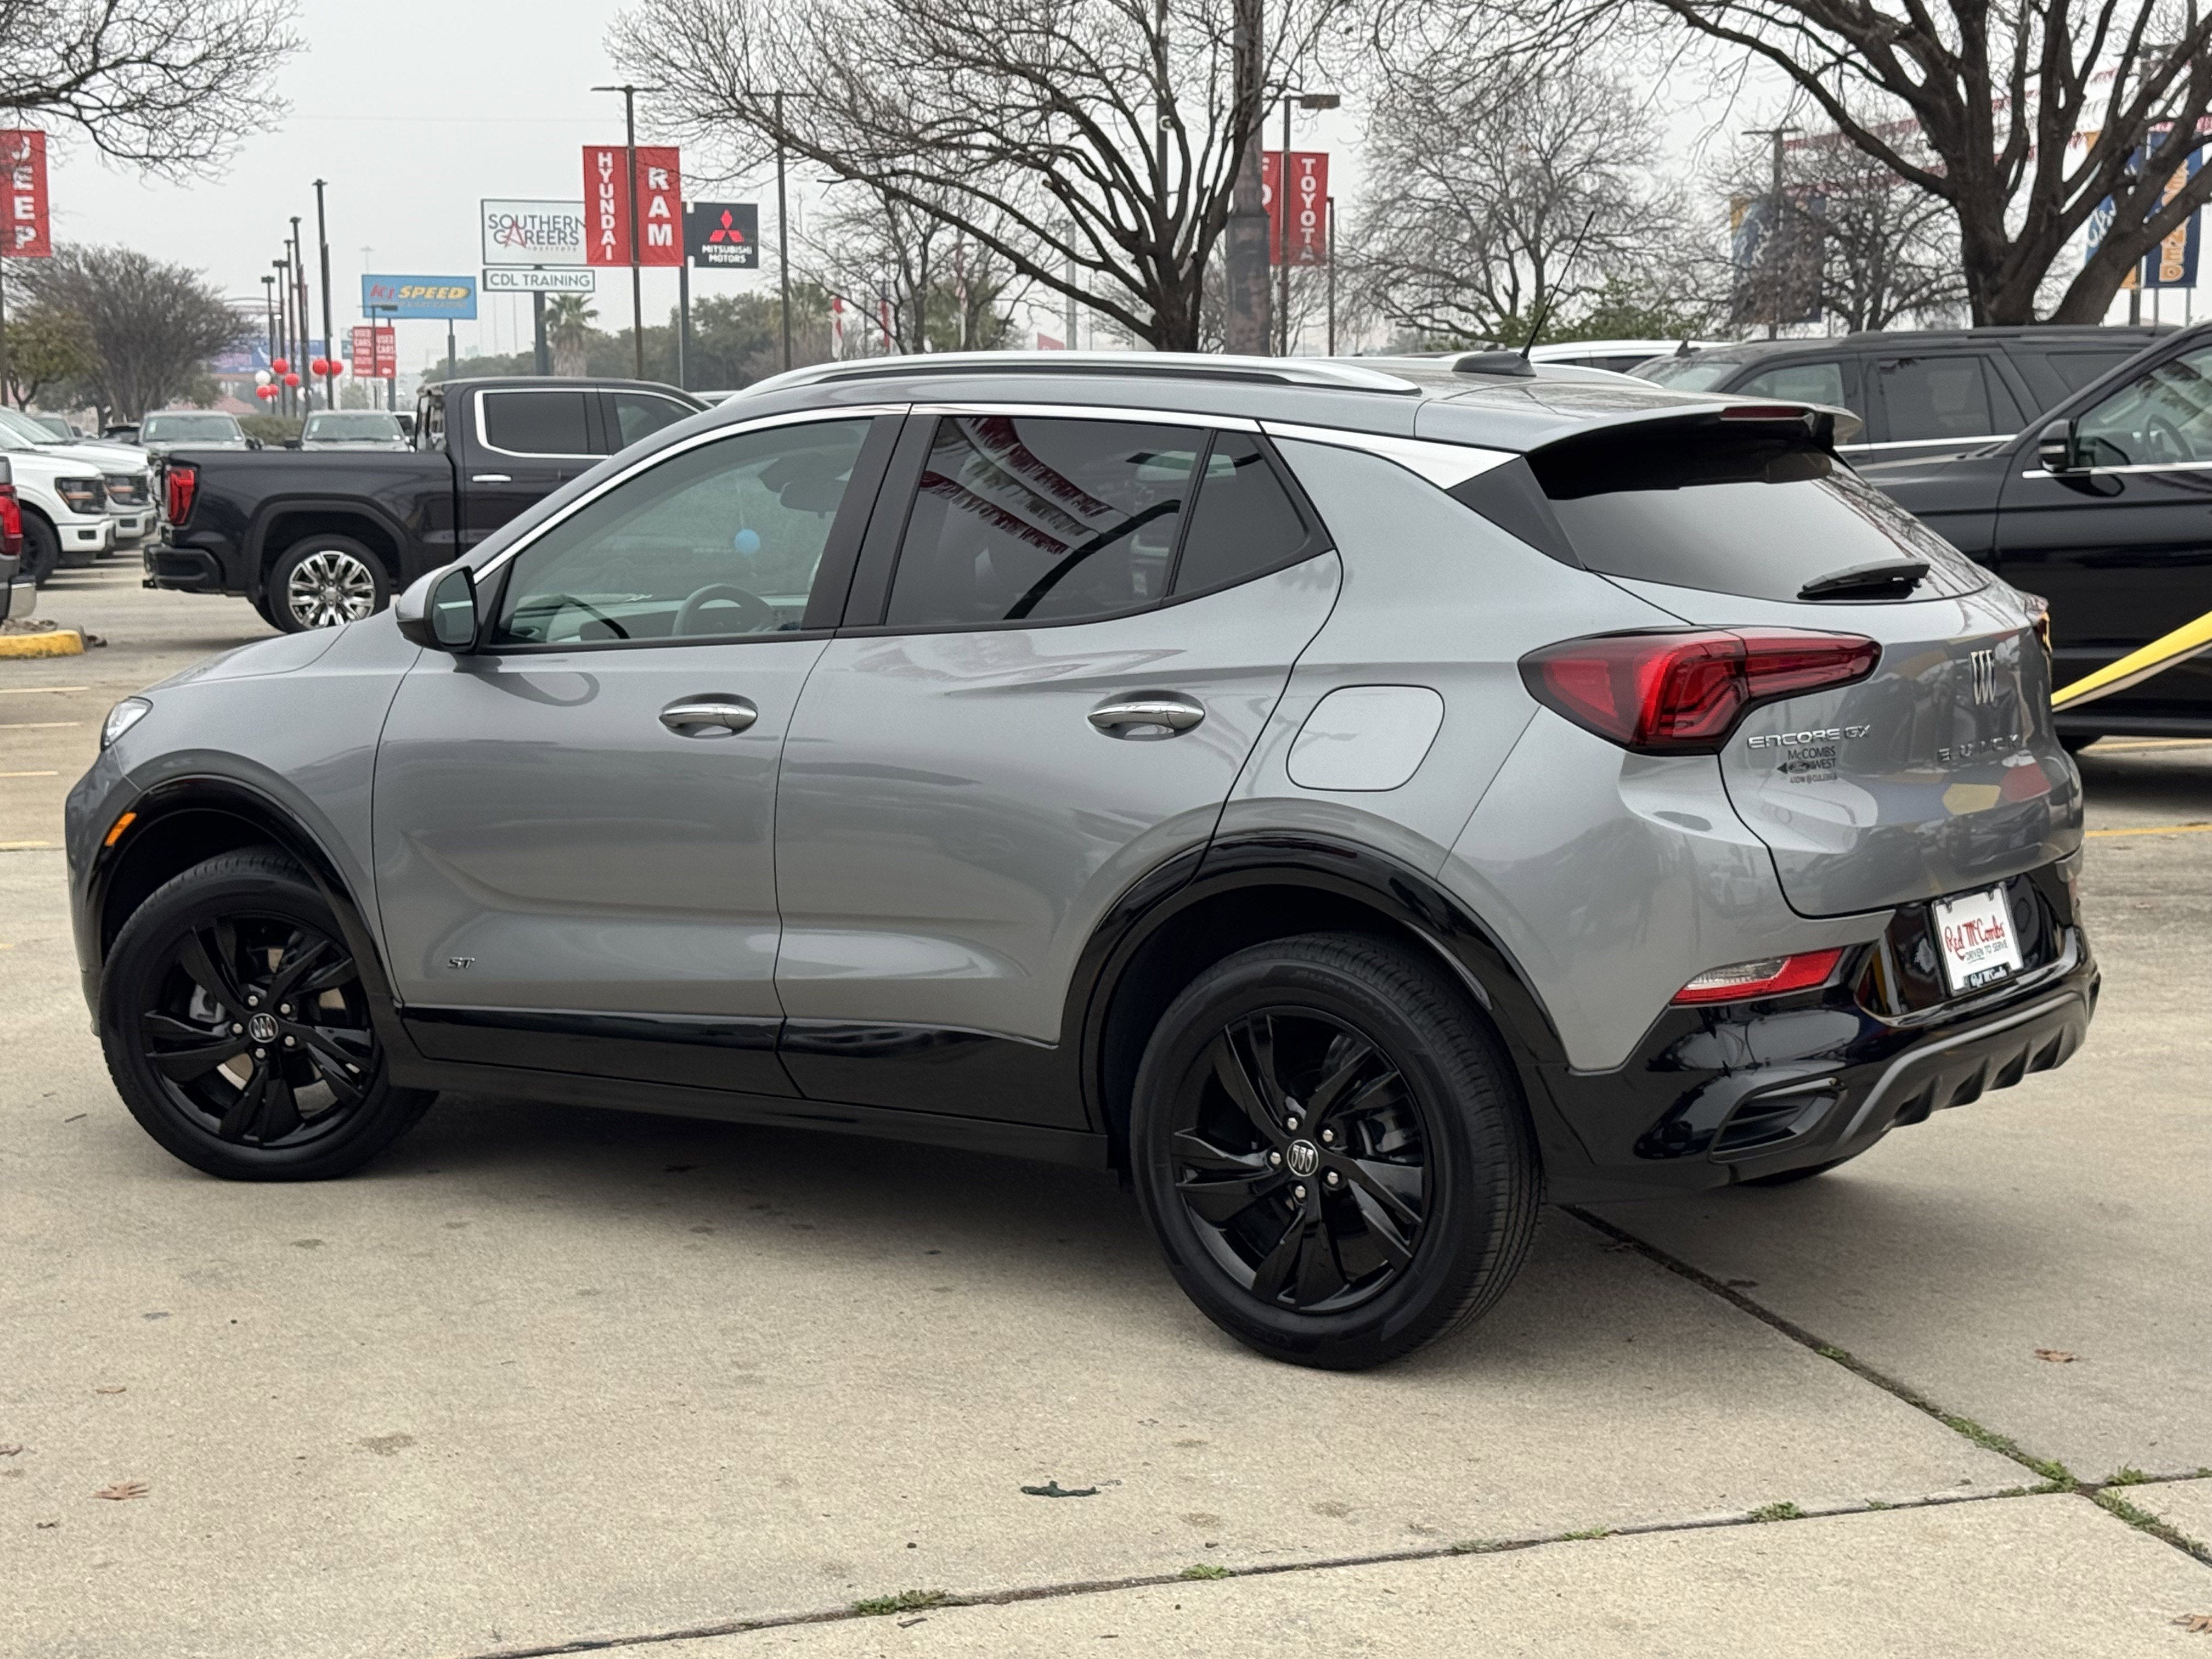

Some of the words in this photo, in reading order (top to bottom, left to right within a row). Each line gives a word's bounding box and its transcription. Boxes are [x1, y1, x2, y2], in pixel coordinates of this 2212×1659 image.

[11, 136, 37, 250] JEEP
[597, 151, 617, 261] HYUNDAI
[647, 166, 673, 247] RAM
[1300, 158, 1317, 261] TOYOTA
[493, 223, 580, 247] CAREERS
[702, 244, 753, 255] MITSUBISHI
[708, 254, 747, 264] MOTORS
[490, 273, 519, 286] CDL
[522, 273, 590, 287] TRAINING
[398, 285, 471, 300] SPEED
[1747, 727, 1841, 749] ENCORE
[1844, 724, 1871, 739] GX
[1787, 746, 1836, 760] McCOMBS
[1944, 923, 1966, 961] Red
